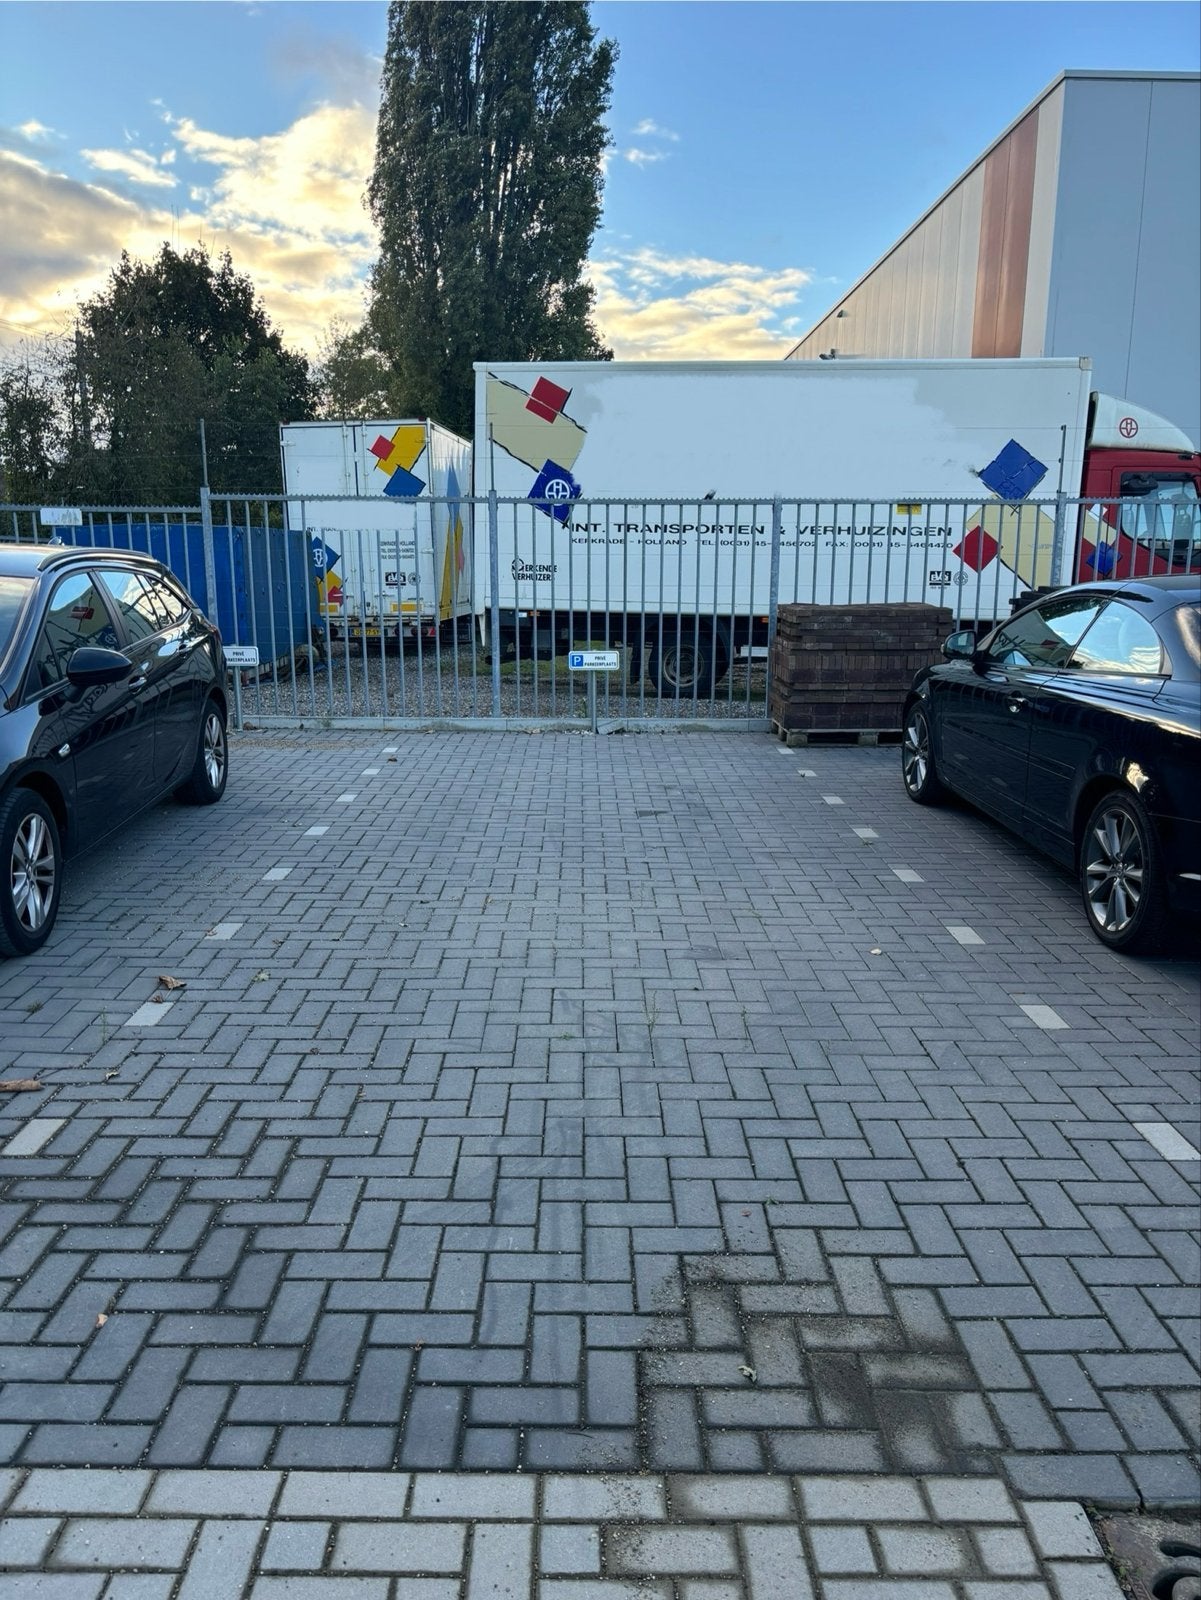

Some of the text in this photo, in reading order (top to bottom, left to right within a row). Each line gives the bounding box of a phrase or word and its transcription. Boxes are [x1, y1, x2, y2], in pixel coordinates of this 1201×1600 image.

[571, 523, 606, 533] INT.
[613, 523, 765, 535] TRANSPORTEN
[795, 525, 953, 537] VERHUIZINGEN
[525, 564, 558, 573] ERKENDE
